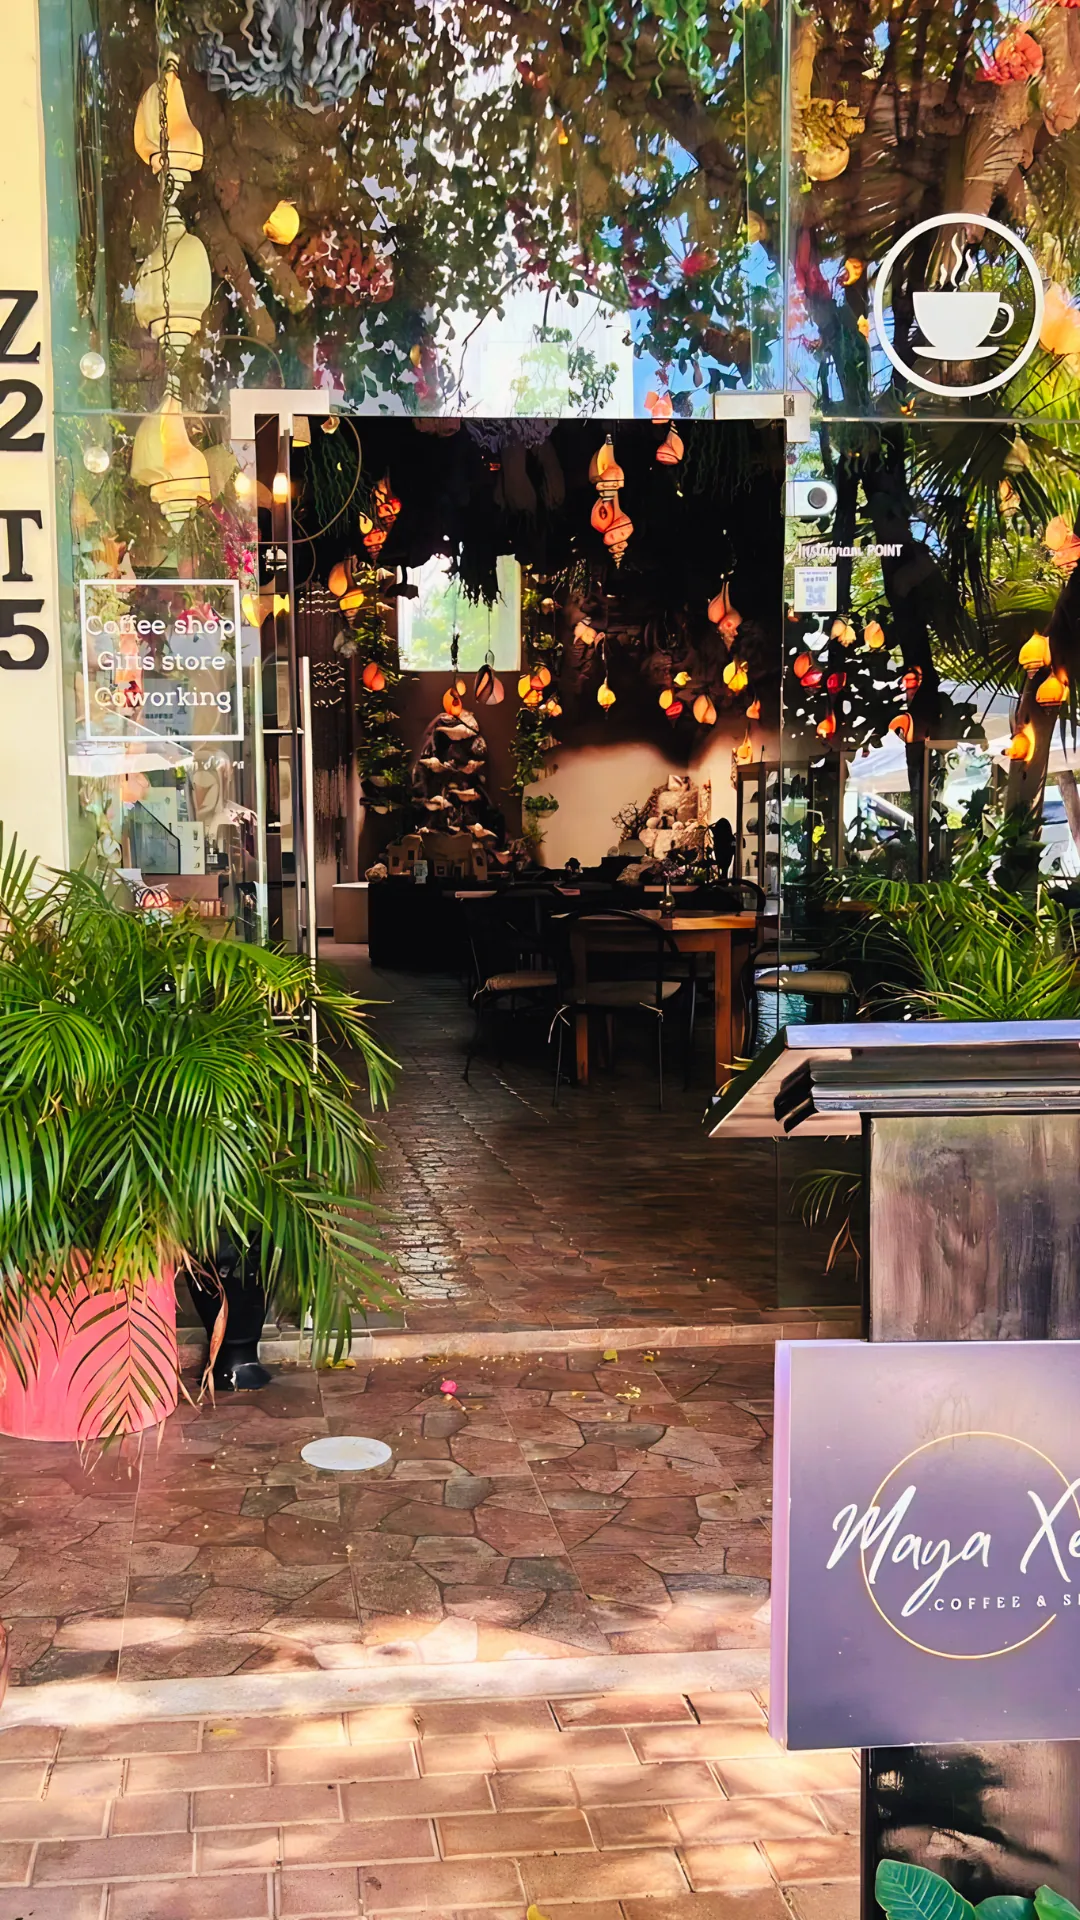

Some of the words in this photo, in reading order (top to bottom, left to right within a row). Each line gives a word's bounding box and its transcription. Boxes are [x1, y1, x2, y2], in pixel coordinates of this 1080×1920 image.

[796, 542, 863, 563] Instagram
[866, 543, 903, 557] POINT
[86, 614, 166, 635] Coffee
[174, 614, 235, 640] shop
[97, 651, 155, 670] Gifts
[161, 654, 226, 670] store
[94, 686, 231, 713] Coworking
[826, 1485, 991, 1617] Maya
[933, 1595, 1021, 1611] COFFEE
[1036, 1594, 1047, 1608] &
[1062, 1593, 1080, 1607] S
